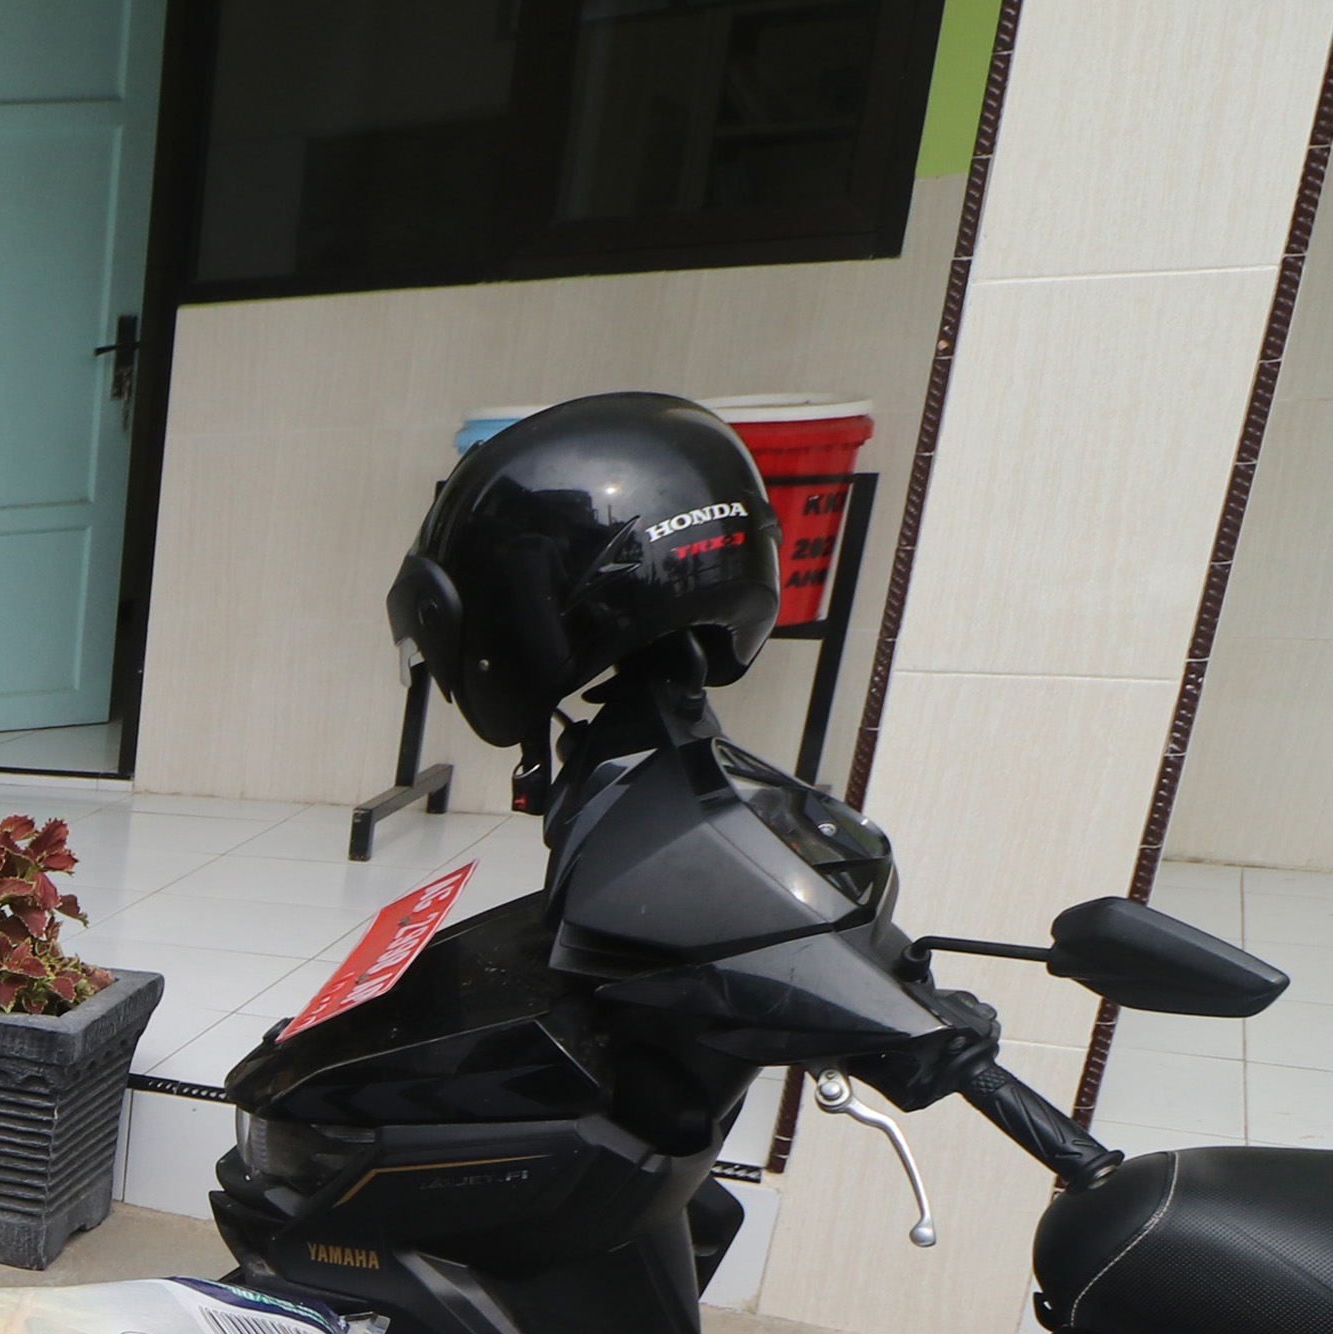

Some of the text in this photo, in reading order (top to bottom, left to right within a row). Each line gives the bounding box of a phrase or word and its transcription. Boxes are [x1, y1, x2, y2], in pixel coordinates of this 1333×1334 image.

[645, 501, 748, 543] HONDA
[671, 532, 745, 561] TRX-3
[308, 1243, 380, 1270] YAMAHA
